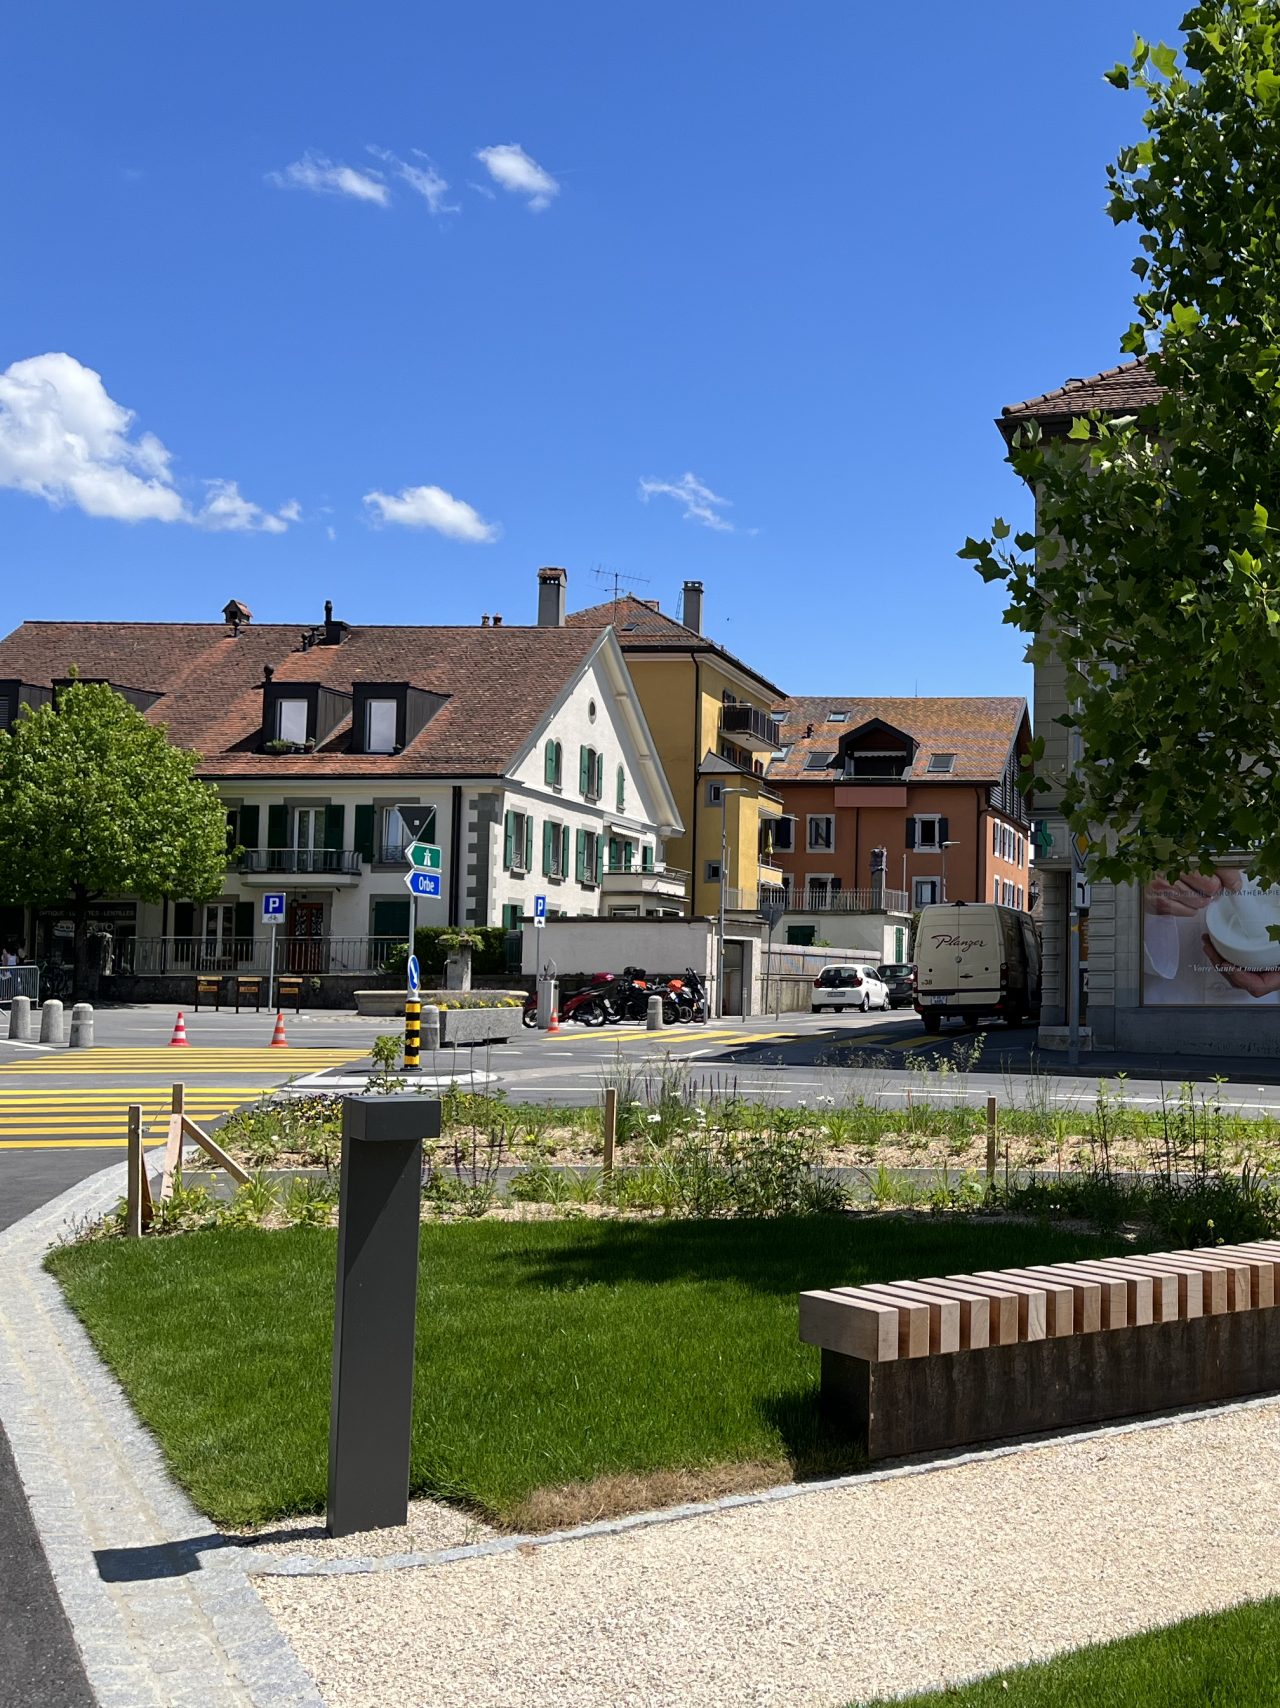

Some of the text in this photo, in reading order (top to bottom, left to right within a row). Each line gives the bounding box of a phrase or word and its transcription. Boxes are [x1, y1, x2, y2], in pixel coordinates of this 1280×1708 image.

[418, 876, 435, 893] Orbe
[269, 898, 279, 912] P
[537, 899, 543, 915] P
[930, 934, 989, 953] Planzer
